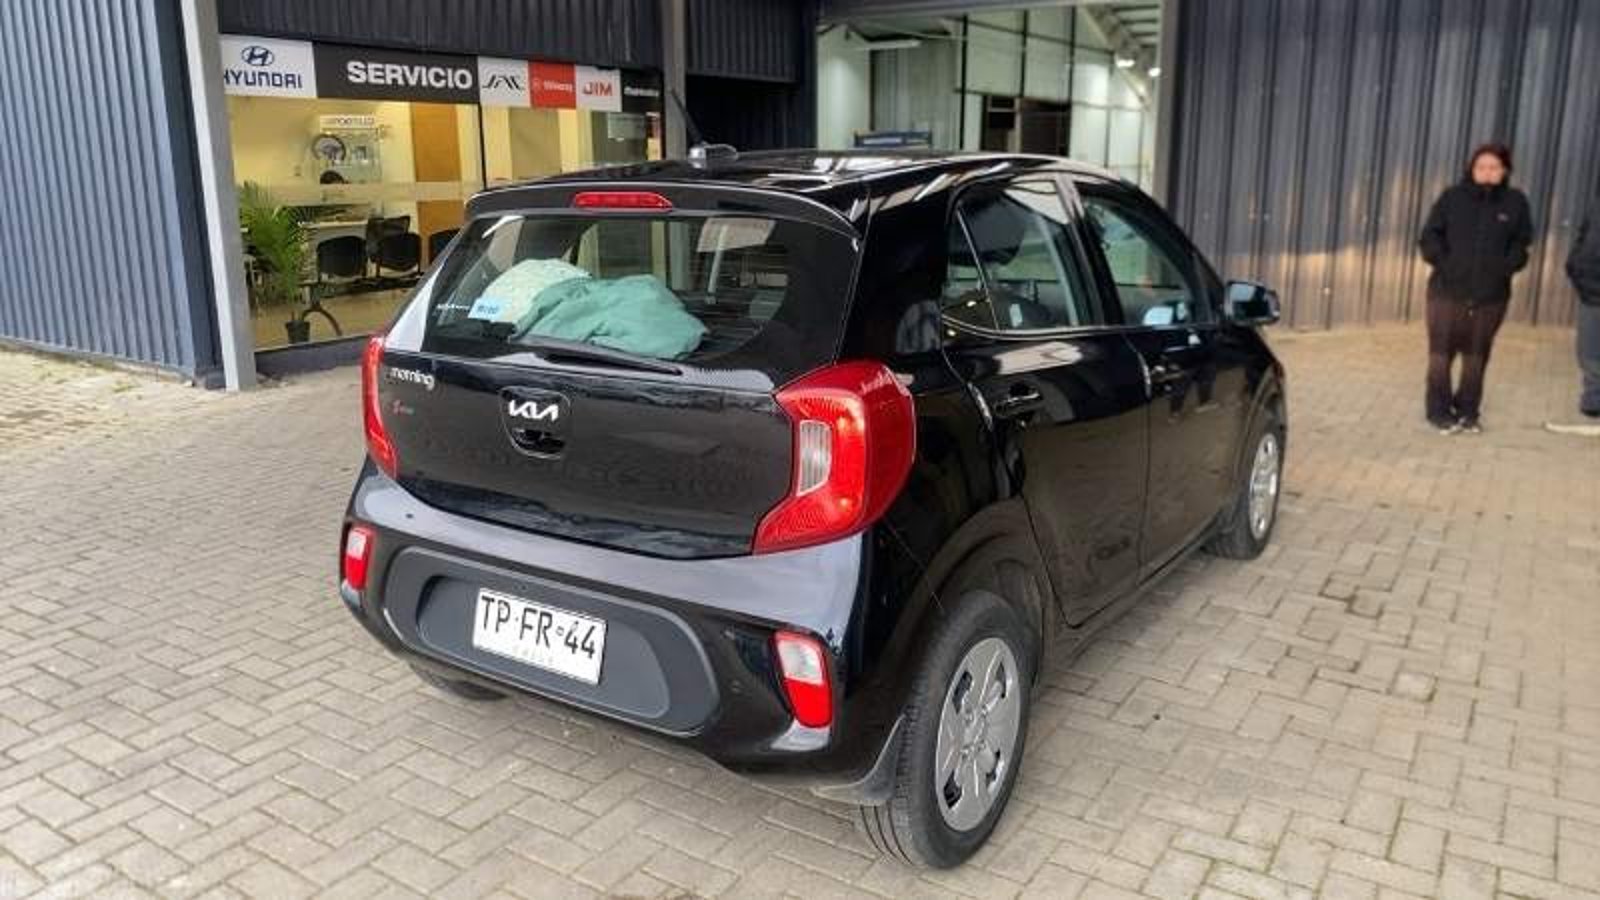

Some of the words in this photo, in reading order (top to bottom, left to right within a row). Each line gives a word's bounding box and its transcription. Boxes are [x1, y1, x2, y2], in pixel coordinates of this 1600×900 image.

[346, 60, 474, 90] SERVICIO
[582, 81, 614, 97] JIM
[390, 366, 435, 391] morning
[508, 399, 560, 422] KIA
